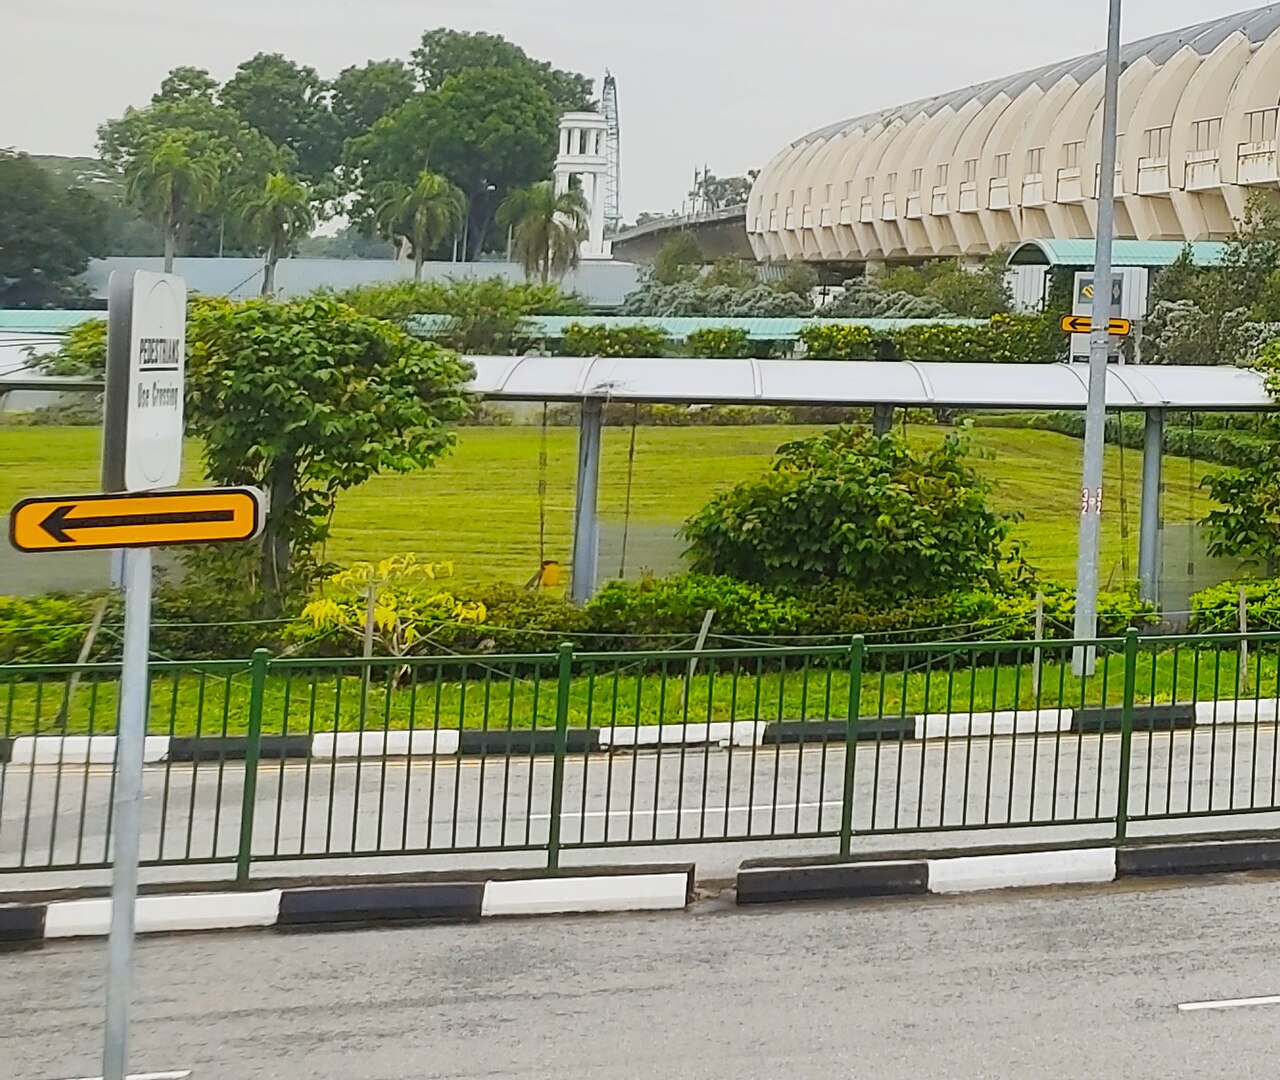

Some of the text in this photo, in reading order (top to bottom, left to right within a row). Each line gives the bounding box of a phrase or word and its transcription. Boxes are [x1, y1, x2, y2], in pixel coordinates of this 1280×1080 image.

[139, 338, 180, 365] PEDESTRIANS
[138, 380, 178, 411] Use Crossing
